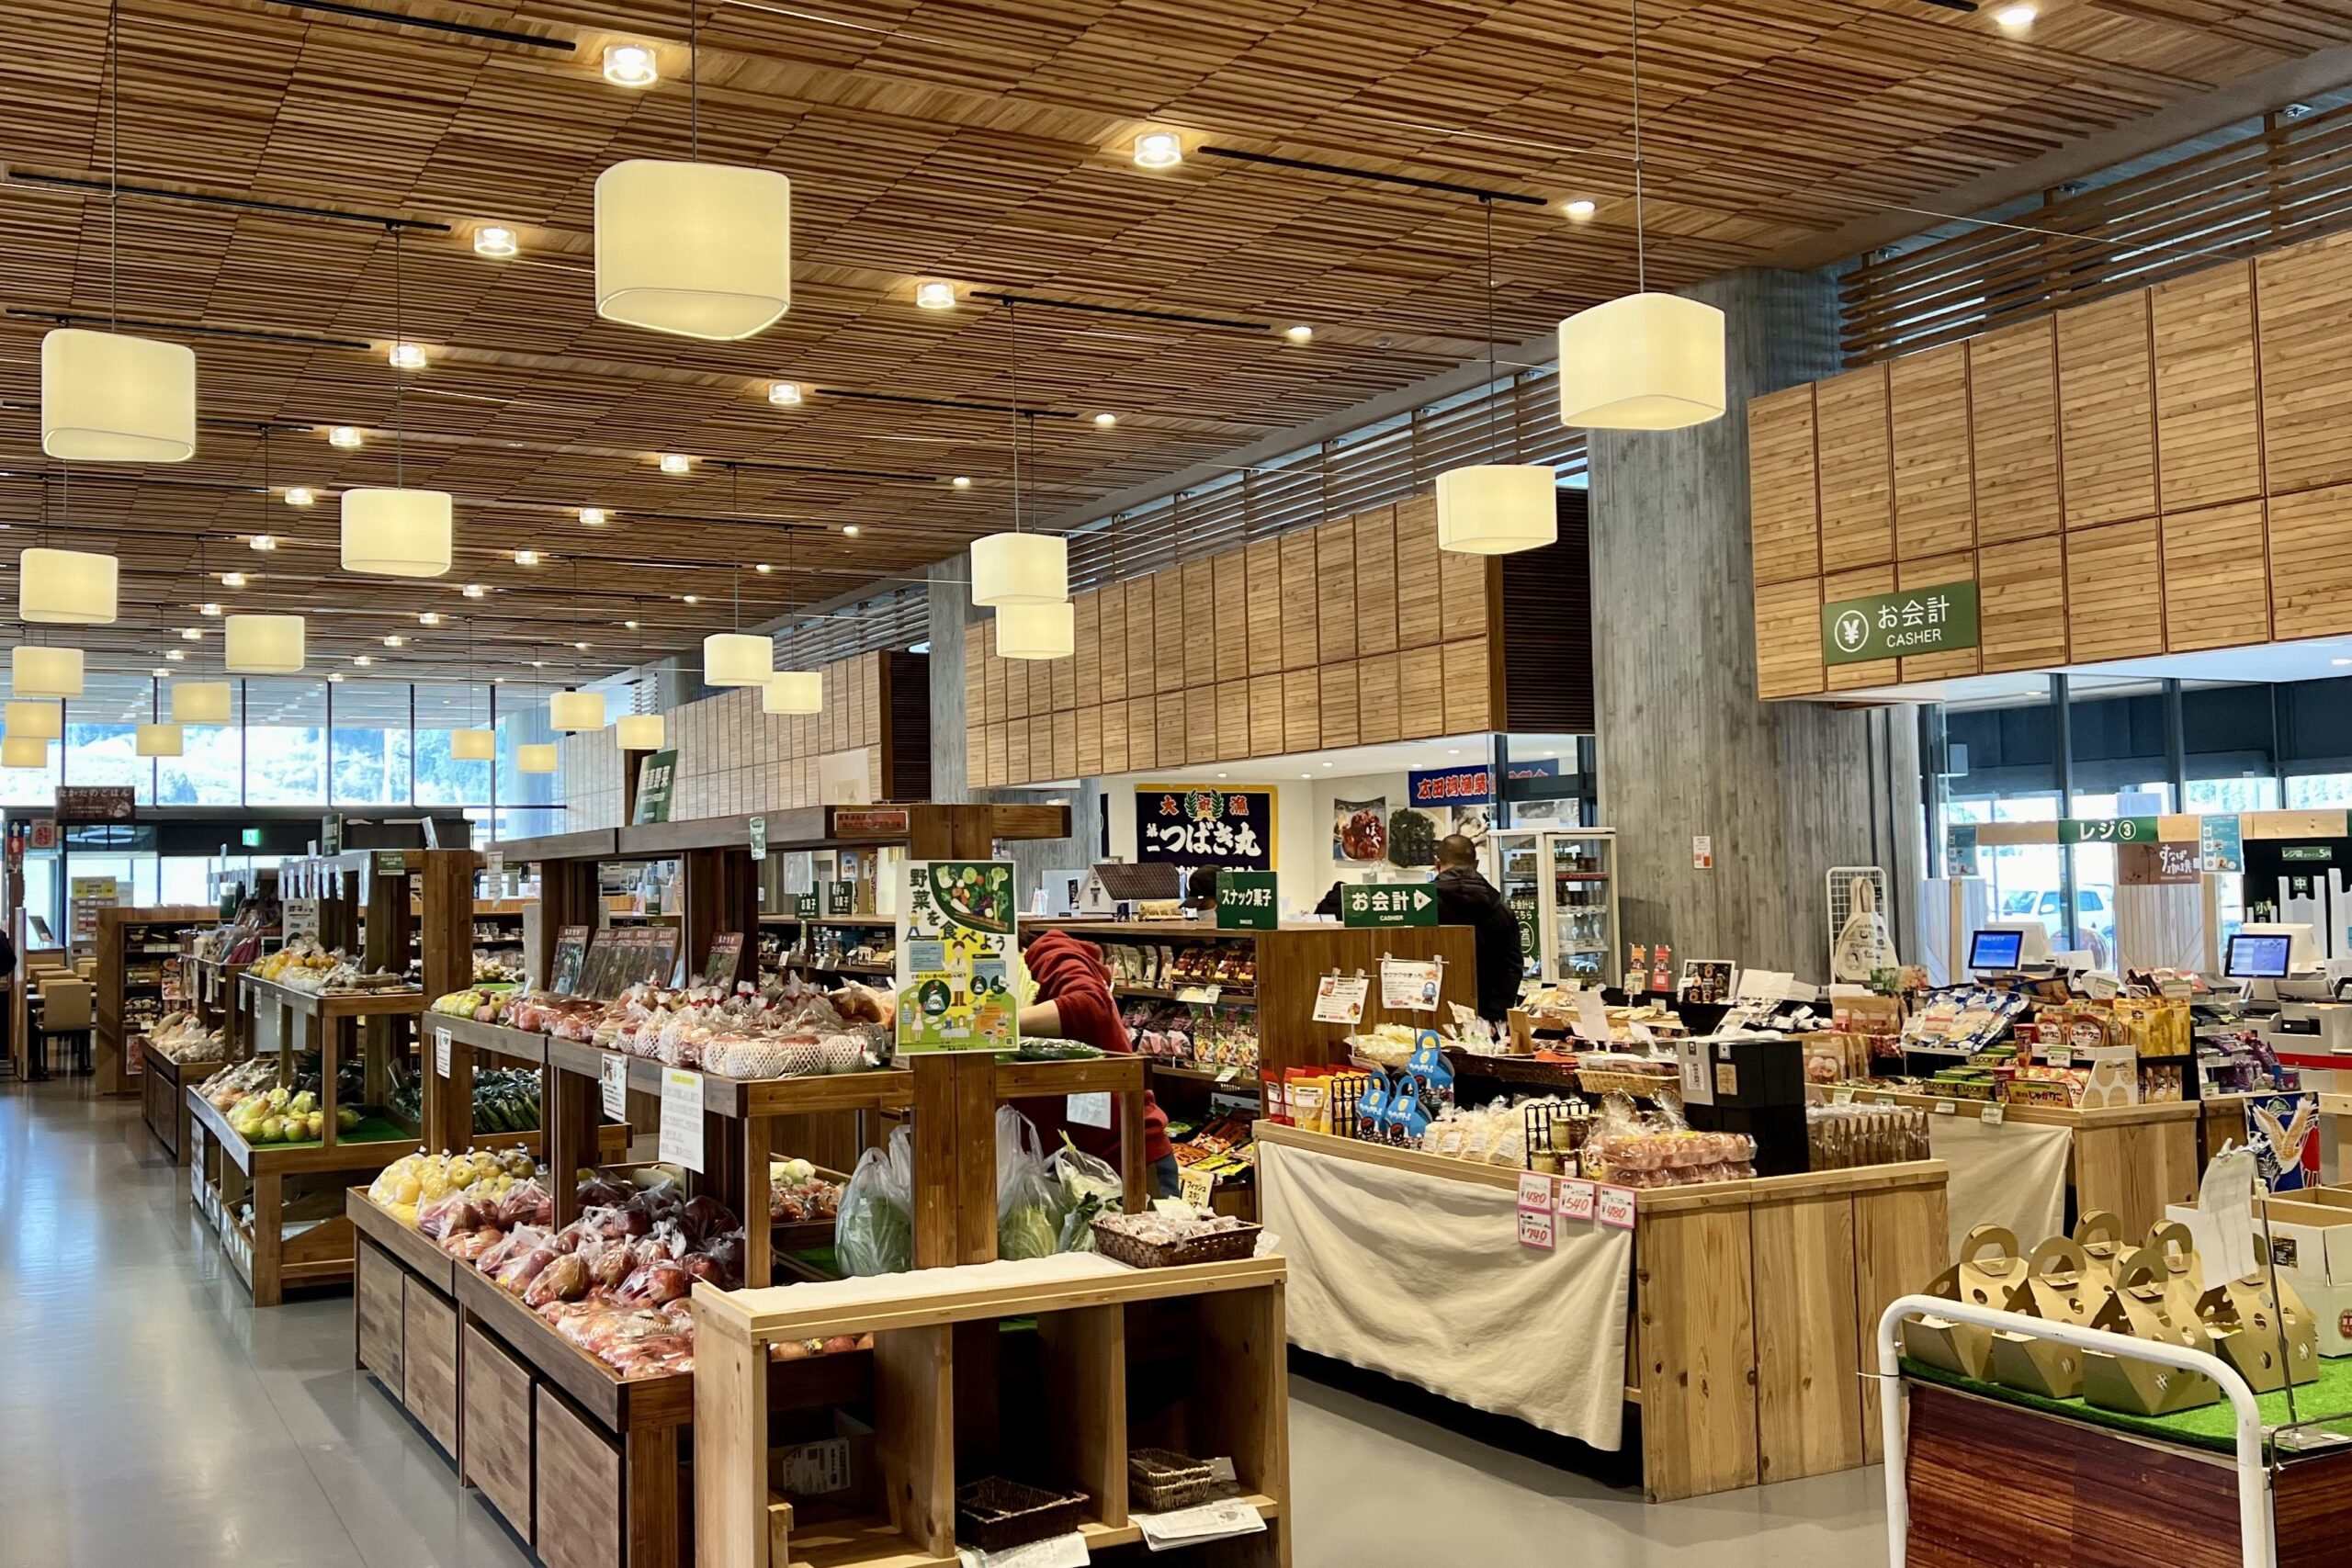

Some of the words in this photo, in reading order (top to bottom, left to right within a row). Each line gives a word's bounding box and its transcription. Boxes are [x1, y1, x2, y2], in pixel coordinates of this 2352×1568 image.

[1877, 594, 1951, 629] お会計
[1886, 628, 1942, 649] CASHER
[1159, 821, 1262, 857] つばき丸
[1365, 821, 1382, 850] ほや
[2294, 877, 2307, 890] 中
[1221, 887, 1272, 908] スナック菓子
[1351, 890, 1410, 912] お会計
[1510, 899, 1535, 910] お会計は
[908, 867, 1006, 952] 野菜を食べよう
[1514, 910, 1532, 920] こちら
[2256, 903, 2267, 915] 小
